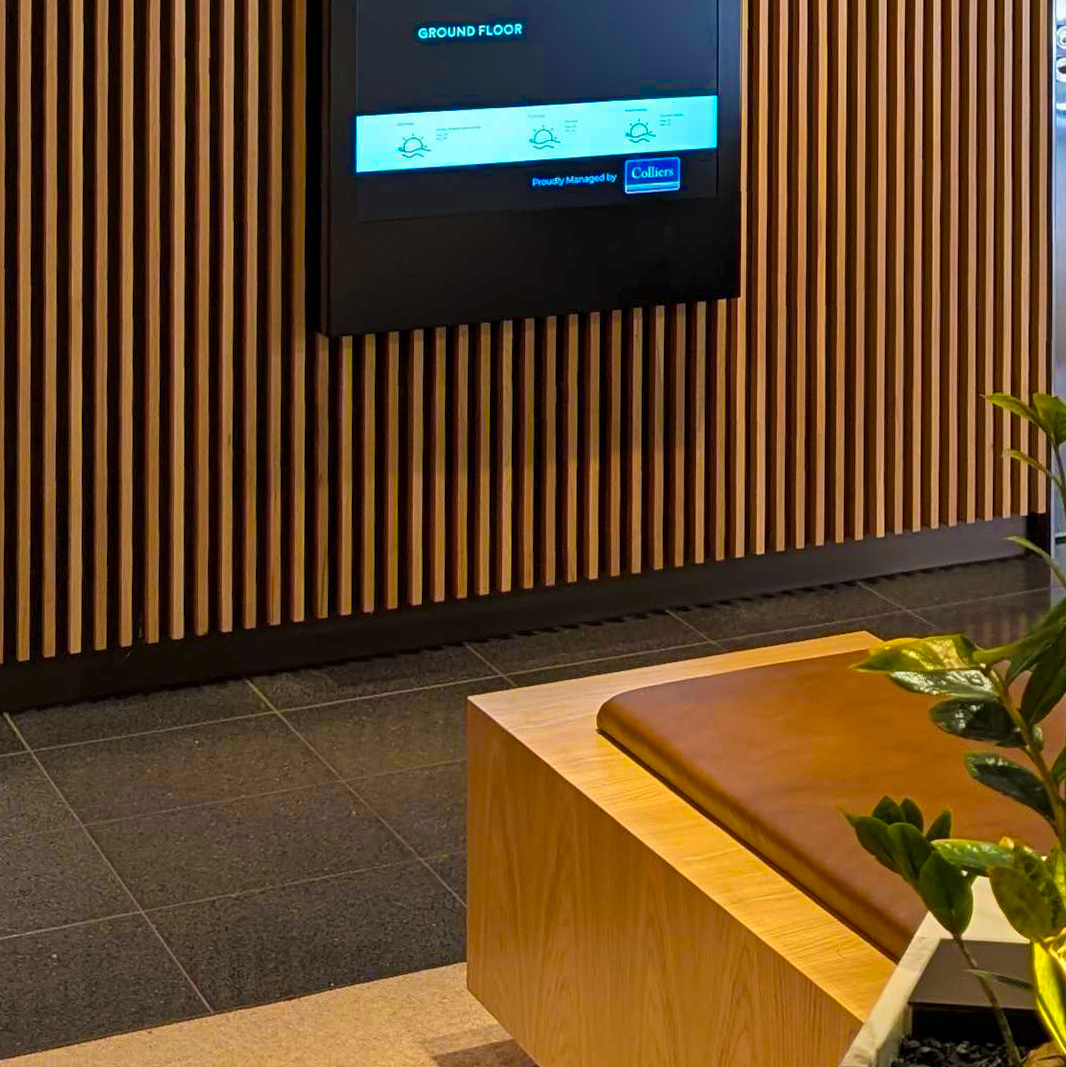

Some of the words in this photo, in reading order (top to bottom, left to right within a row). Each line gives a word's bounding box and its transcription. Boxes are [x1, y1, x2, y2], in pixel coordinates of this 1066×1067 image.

[417, 25, 476, 40] GROUND
[478, 23, 523, 37] FLOOR
[531, 177, 565, 188] Proudly
[565, 174, 605, 187] Managed
[606, 173, 617, 183] by
[631, 166, 675, 180] Colliers
